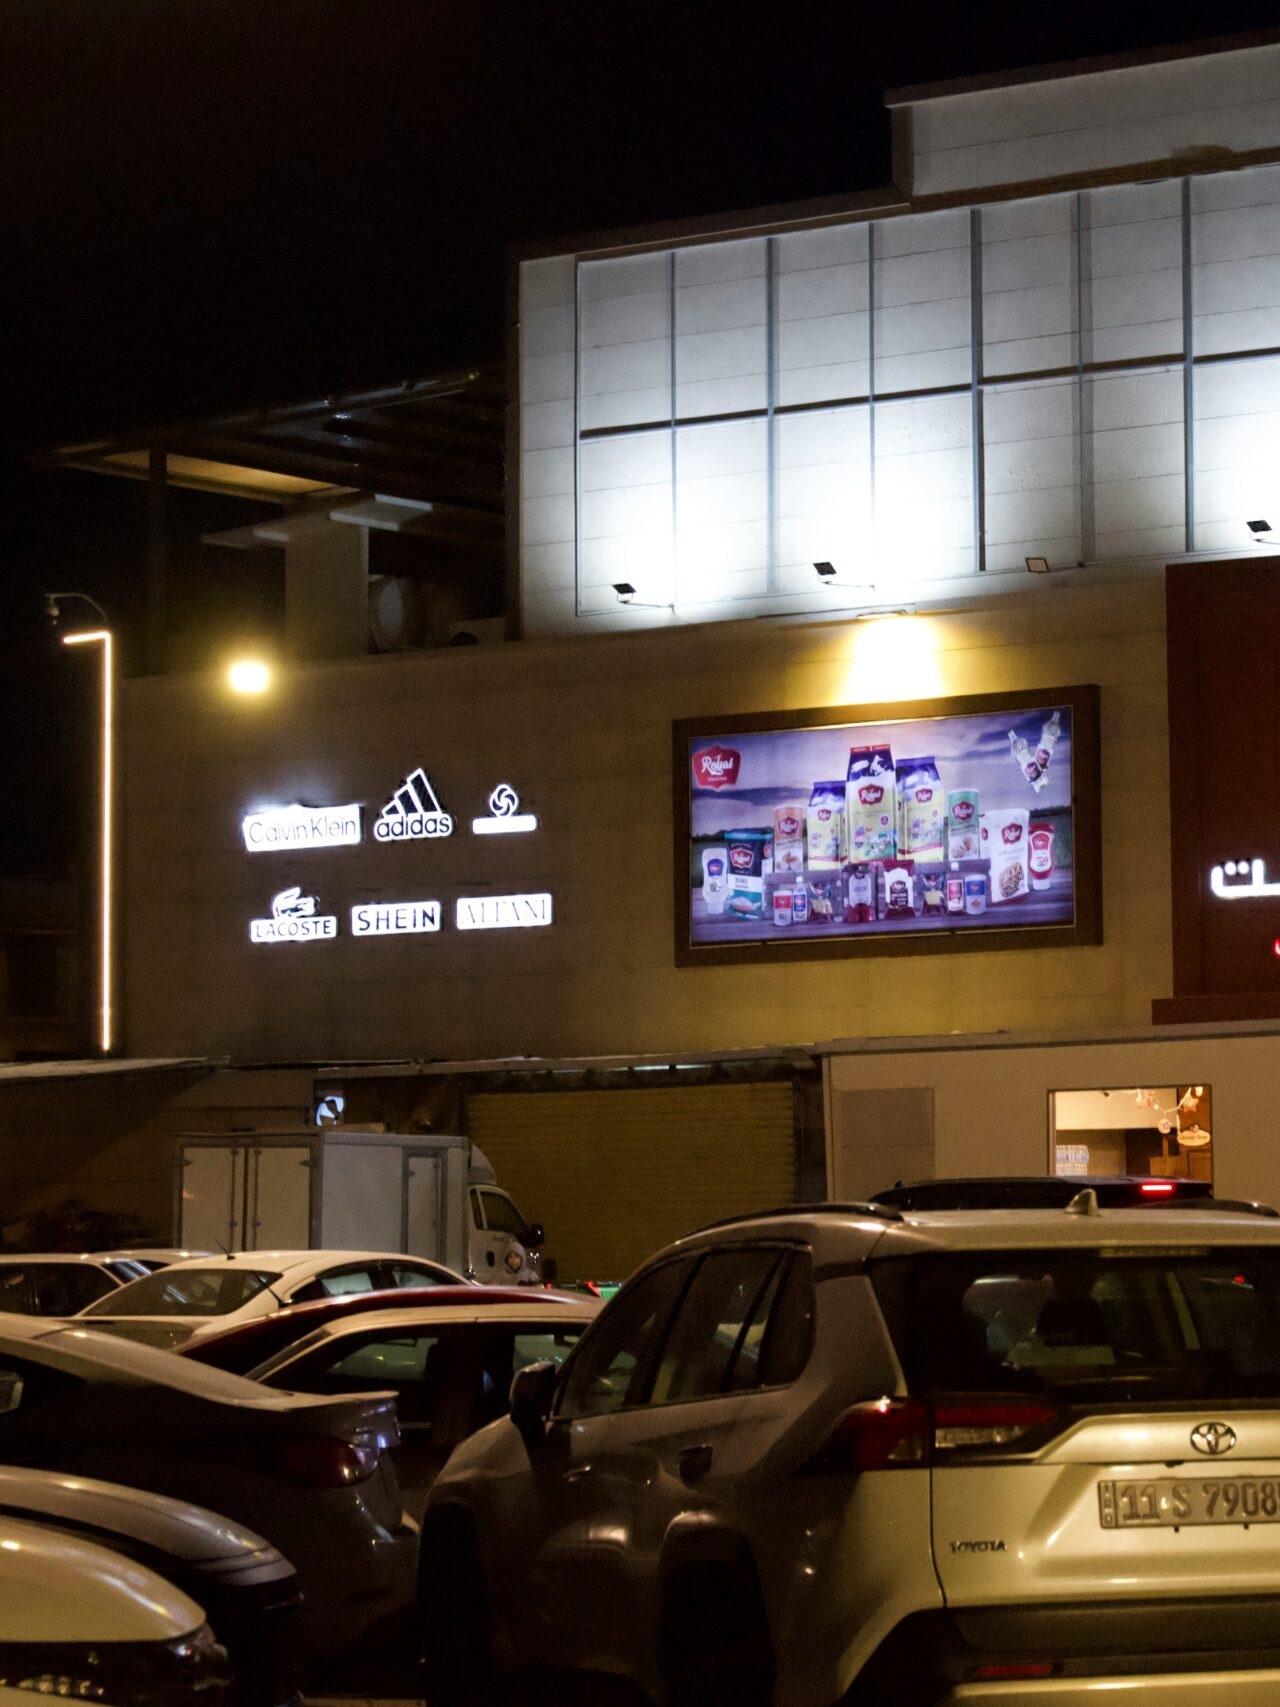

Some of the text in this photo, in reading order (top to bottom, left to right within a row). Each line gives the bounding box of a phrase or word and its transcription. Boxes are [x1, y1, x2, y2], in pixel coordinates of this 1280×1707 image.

[701, 755, 734, 776] Royal
[248, 815, 356, 844] Calvin Klein
[376, 815, 451, 838] adidas
[255, 919, 332, 939] LACOSTE
[356, 905, 436, 932] SHEIN
[1121, 1484, 1160, 1520] 11
[1172, 1483, 1192, 1518] S
[950, 1540, 1007, 1554] TOYOTA
